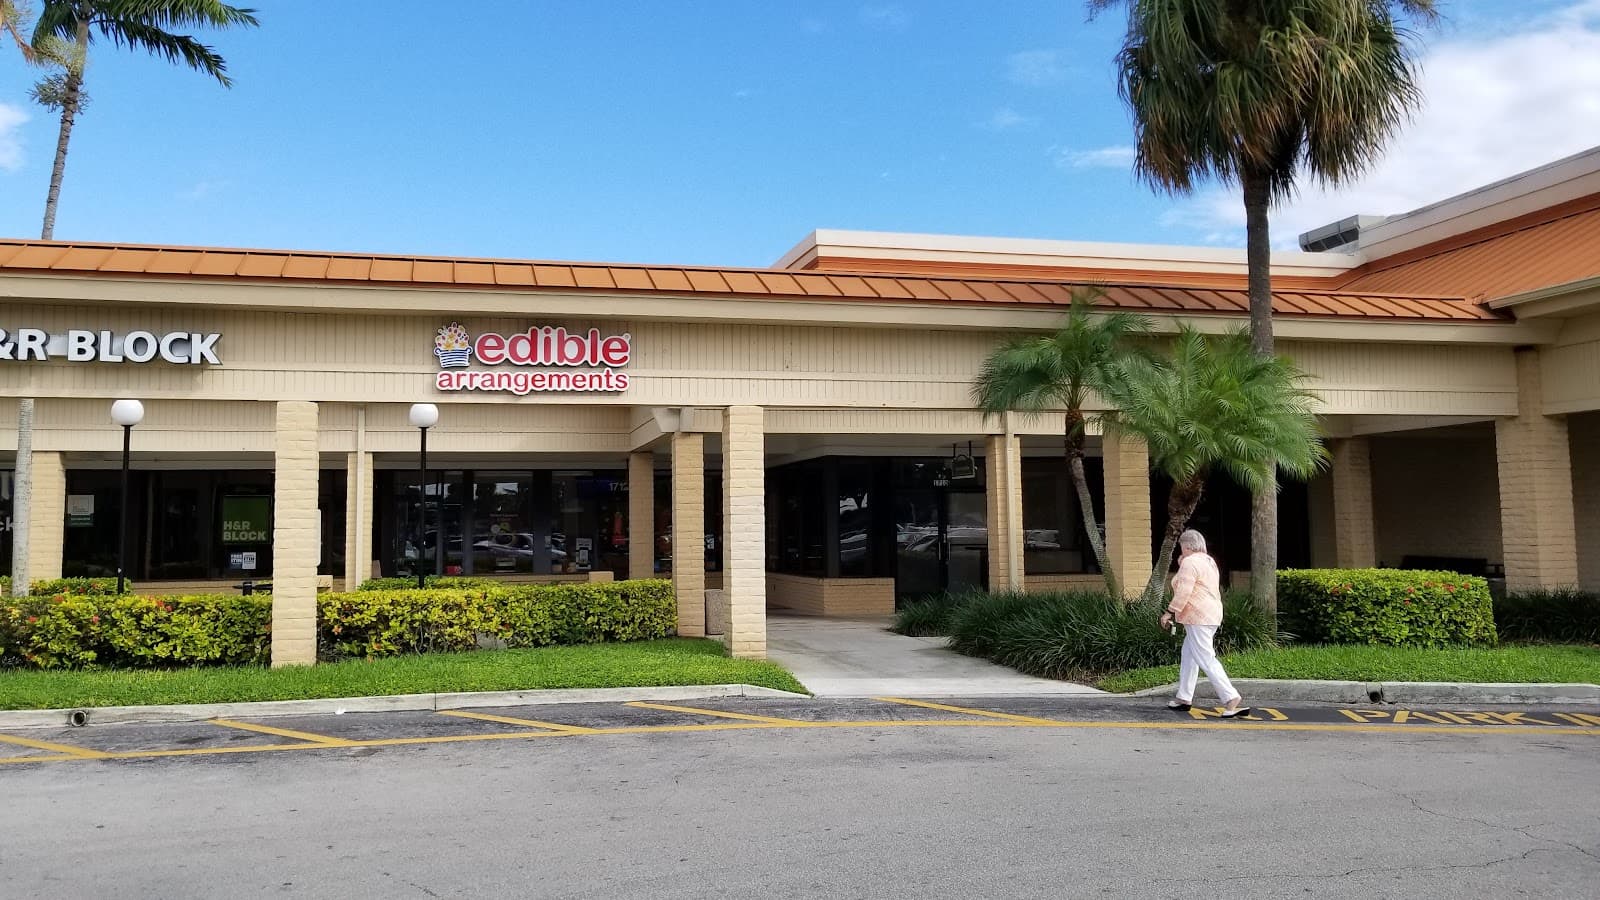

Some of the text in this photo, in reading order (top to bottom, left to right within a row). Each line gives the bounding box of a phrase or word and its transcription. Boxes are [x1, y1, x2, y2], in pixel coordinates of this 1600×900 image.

[68, 329, 222, 365] BLOCK
[476, 326, 630, 365] edible
[437, 368, 629, 394] arrangements
[223, 520, 250, 530] H&R
[223, 531, 266, 541] BLOCK
